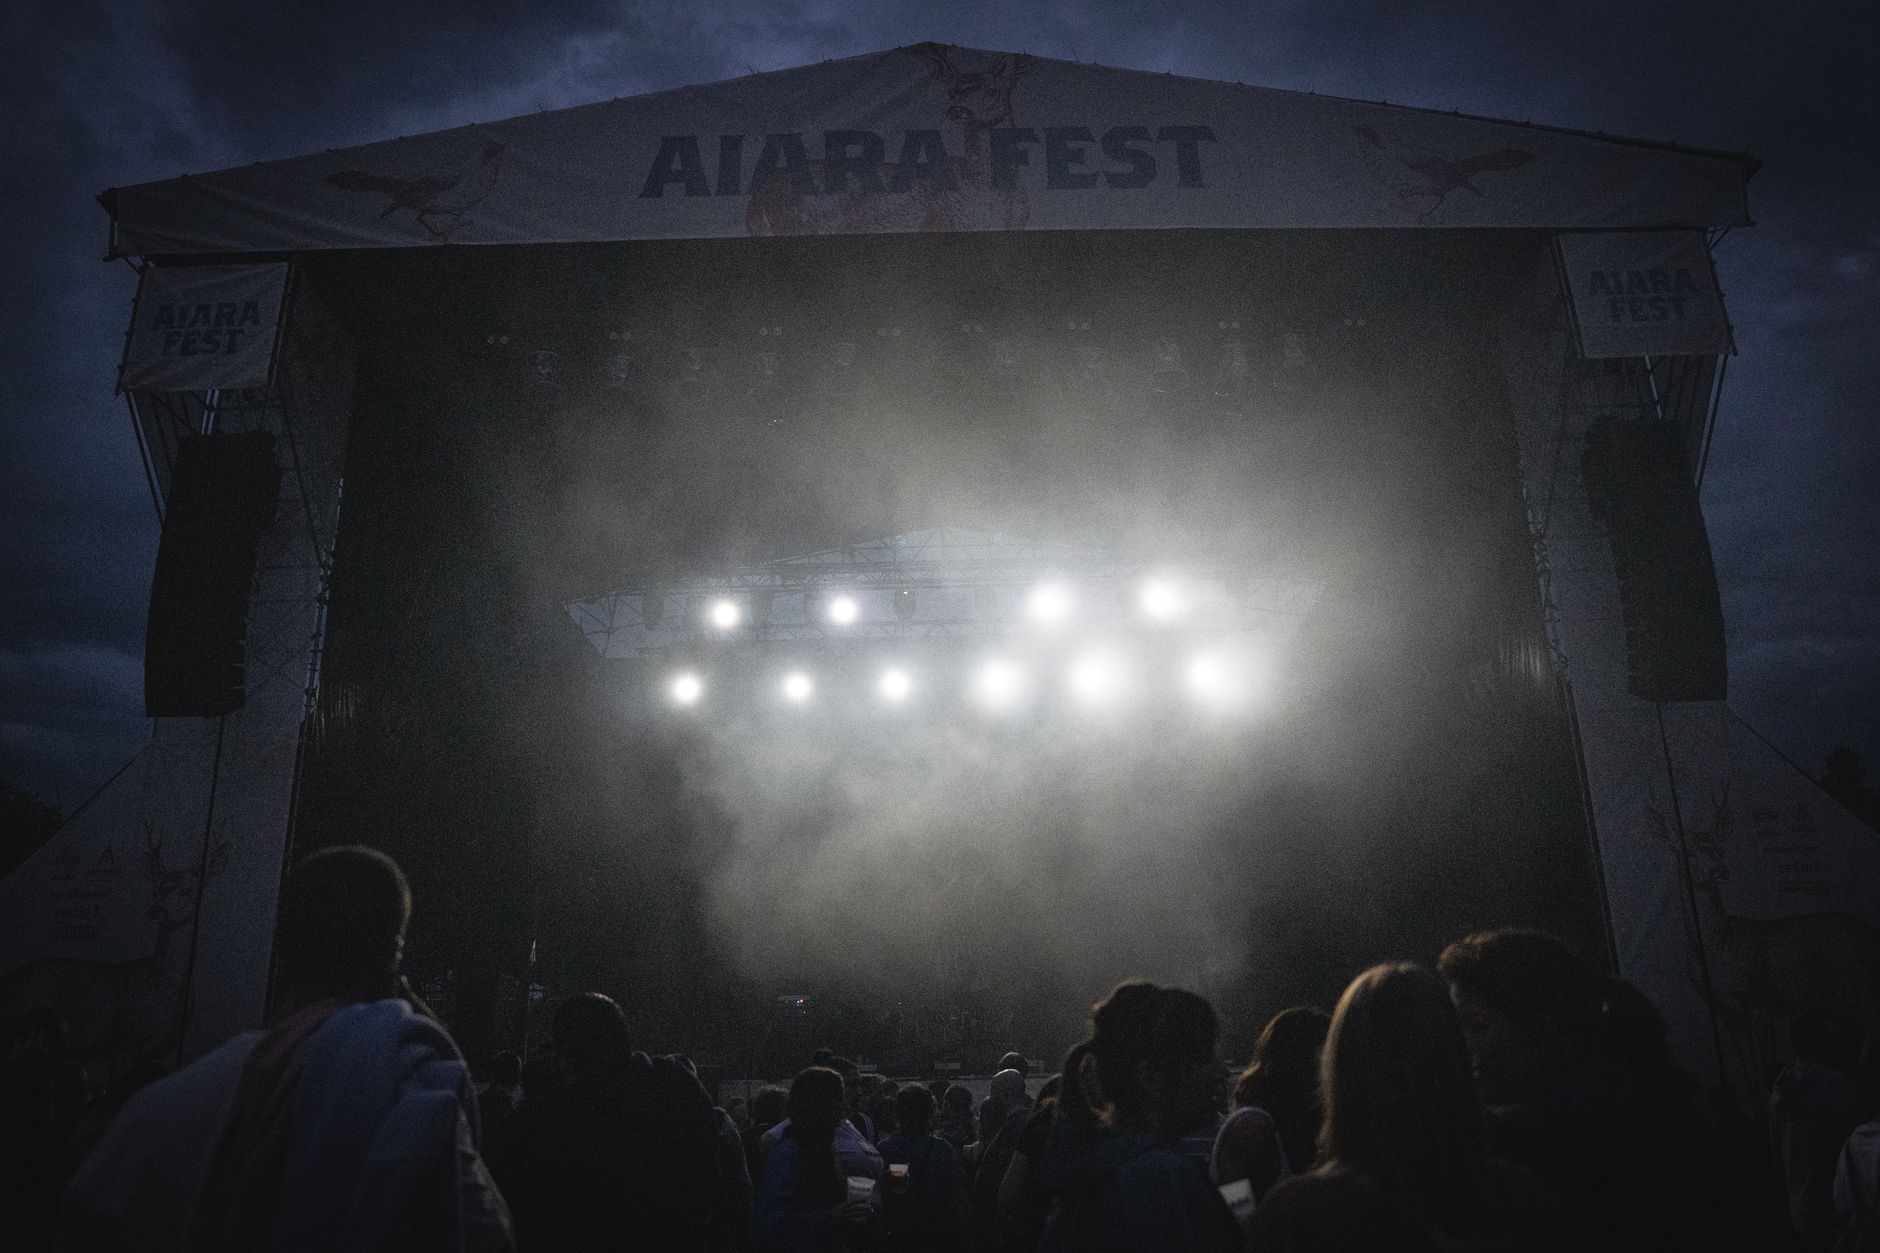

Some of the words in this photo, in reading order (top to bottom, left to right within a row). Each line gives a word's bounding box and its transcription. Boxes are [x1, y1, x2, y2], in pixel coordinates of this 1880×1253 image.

[639, 130, 965, 198] AIARA
[991, 125, 1217, 190] FEST
[1590, 268, 1699, 295] AIARA
[152, 301, 260, 331] AIARA
[1608, 296, 1686, 323] FEST
[162, 329, 244, 356] FEST
